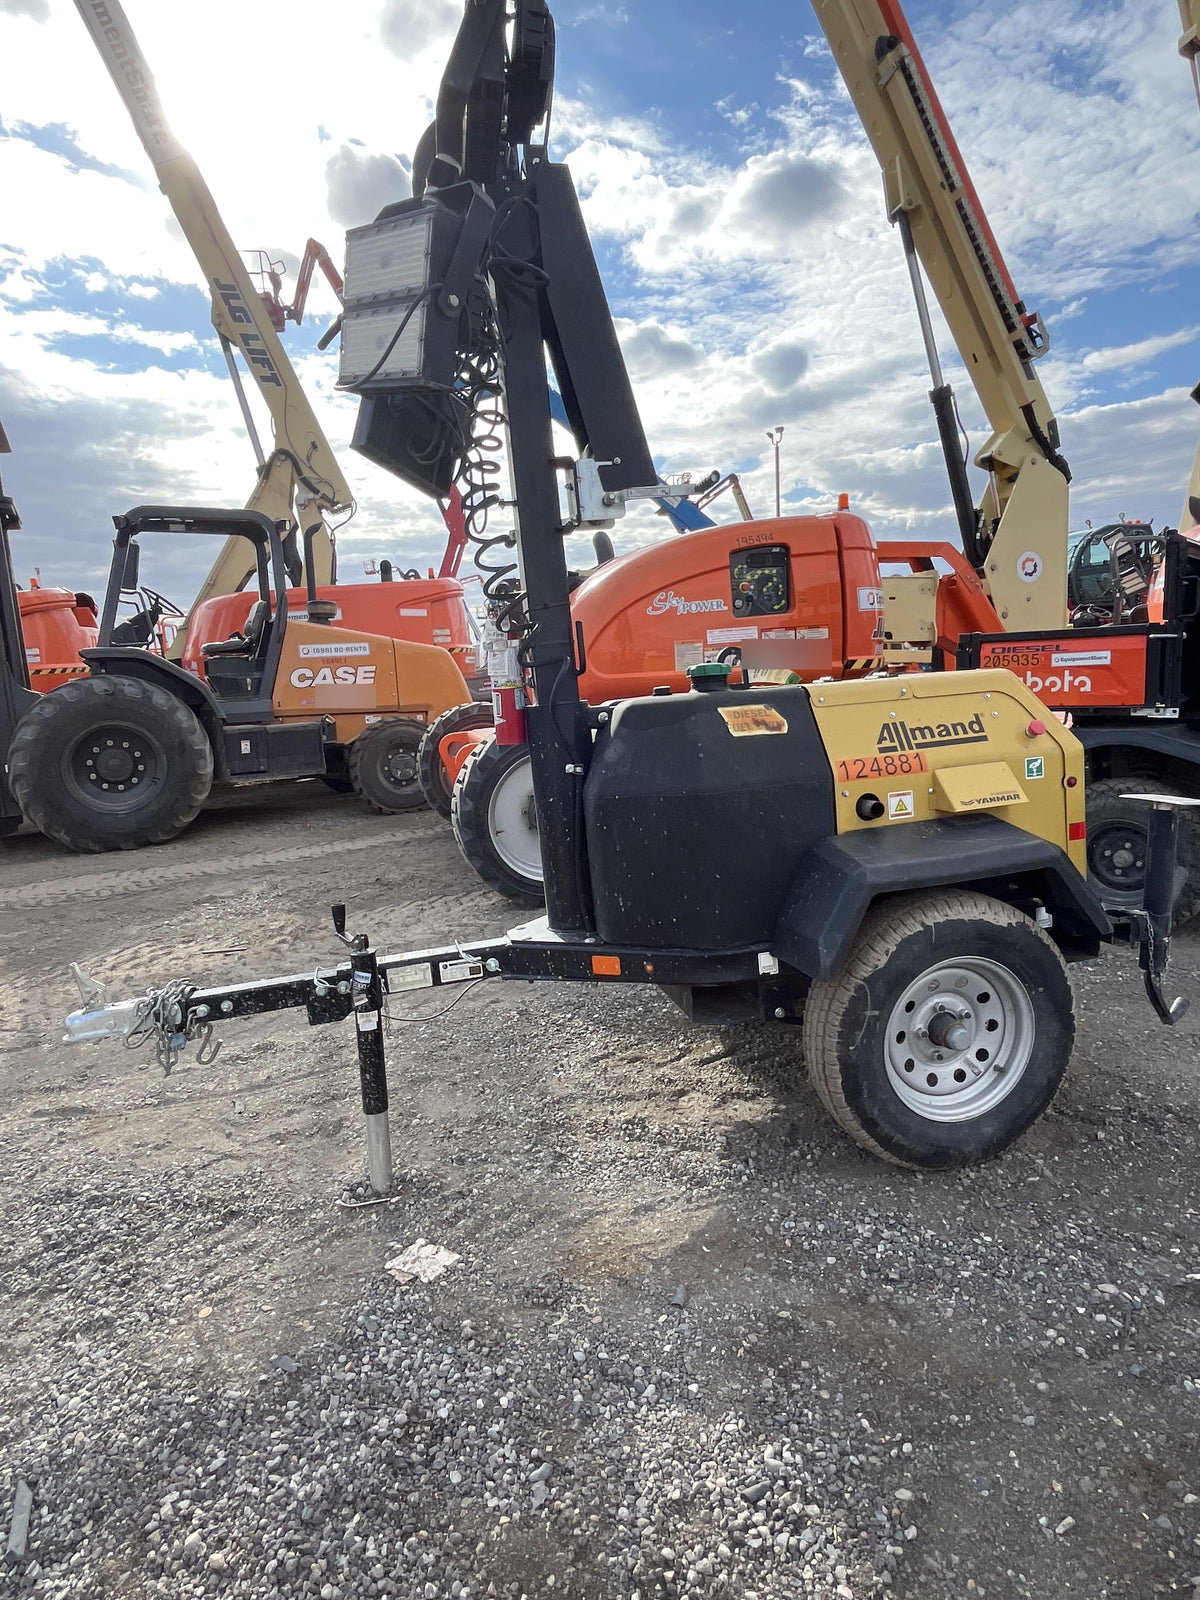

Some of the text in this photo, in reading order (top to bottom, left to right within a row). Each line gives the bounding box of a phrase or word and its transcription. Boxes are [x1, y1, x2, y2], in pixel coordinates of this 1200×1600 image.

[91, 0, 168, 144] mentShare
[213, 278, 282, 387] JLG LIFT
[736, 532, 774, 547] 195494
[991, 644, 1061, 654] DIESEL
[983, 653, 1039, 668] 205935
[290, 665, 377, 689] CASE
[1018, 670, 1092, 692] bota
[733, 709, 770, 719] DIESEL
[729, 722, 754, 732] UEL
[876, 713, 989, 753] Allmand
[839, 752, 926, 780] 124881
[975, 793, 1021, 805] YANMAR
